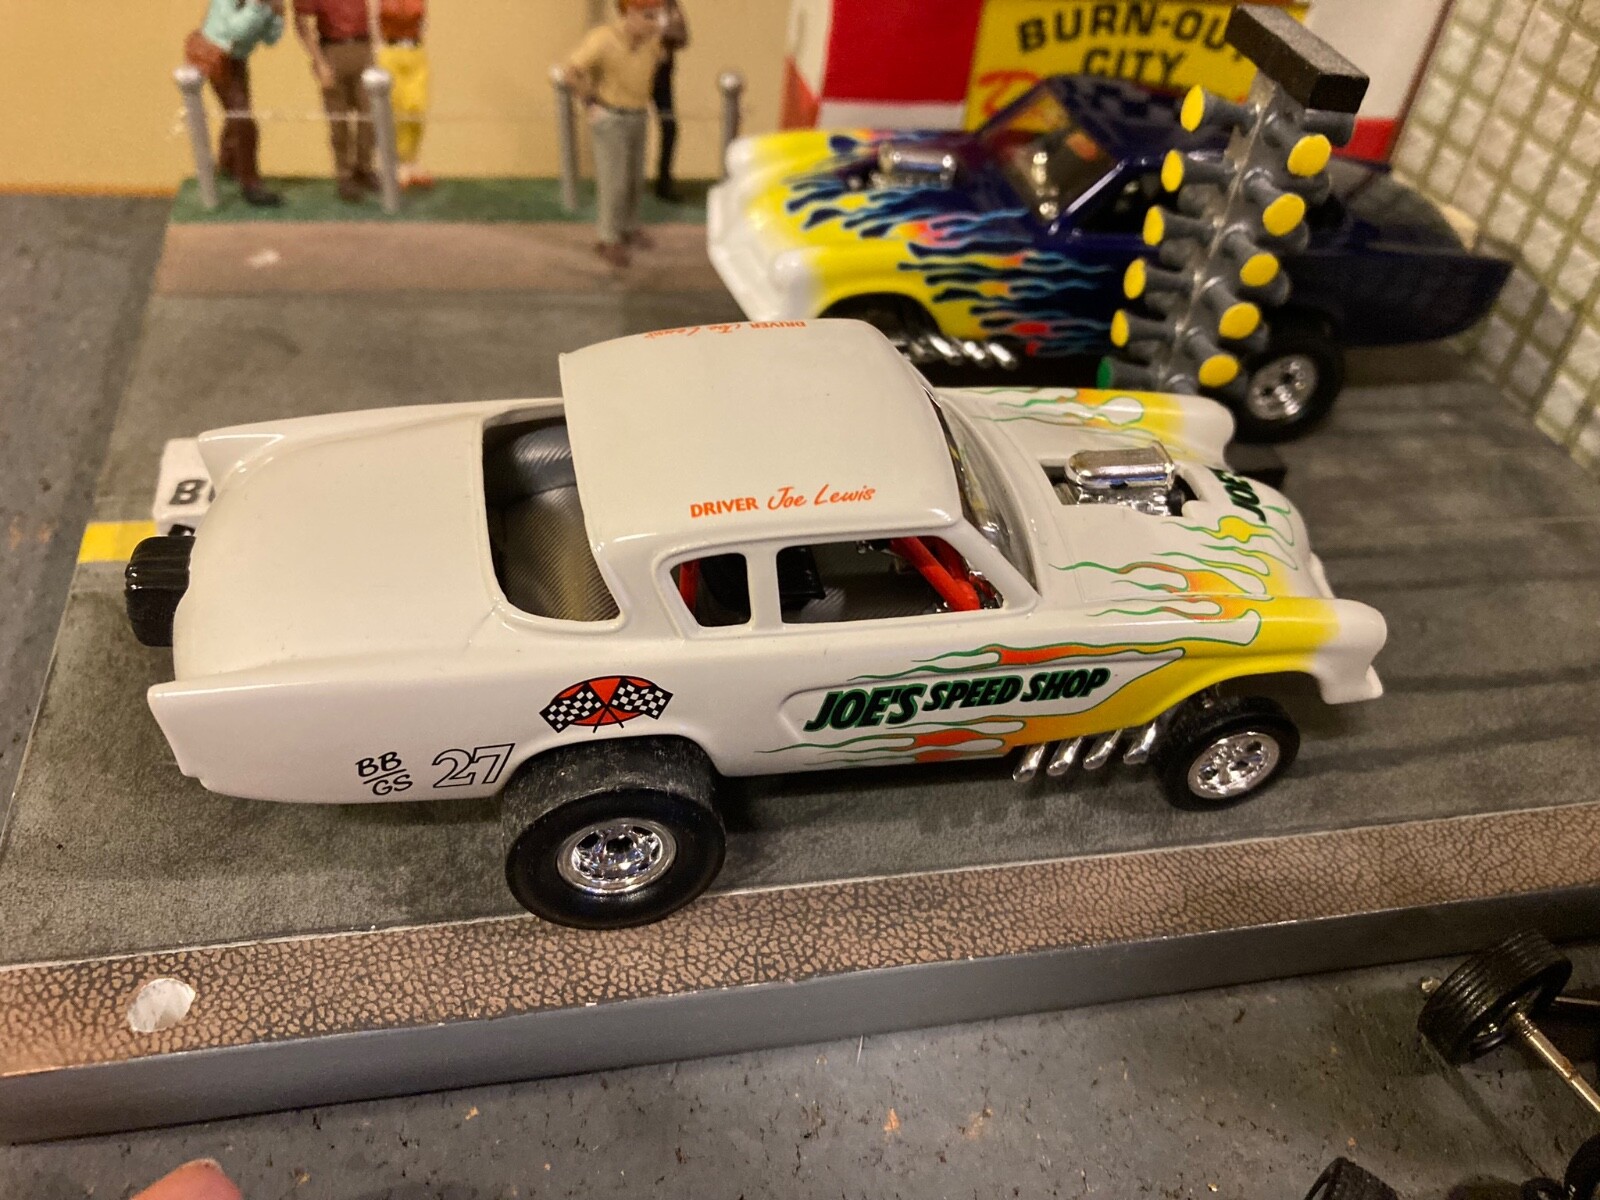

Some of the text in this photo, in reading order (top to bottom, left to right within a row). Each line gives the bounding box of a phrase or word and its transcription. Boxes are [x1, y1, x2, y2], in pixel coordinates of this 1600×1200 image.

[1017, 4, 1243, 62] BURN-OU
[1082, 47, 1187, 84] CITY
[169, 479, 216, 505] B
[690, 484, 876, 518] DRIVER Joe Lewis
[803, 667, 1111, 732] JOE'S SPEED SHOP
[355, 751, 403, 778] BB
[431, 743, 516, 789] 27
[372, 774, 413, 796] GS
